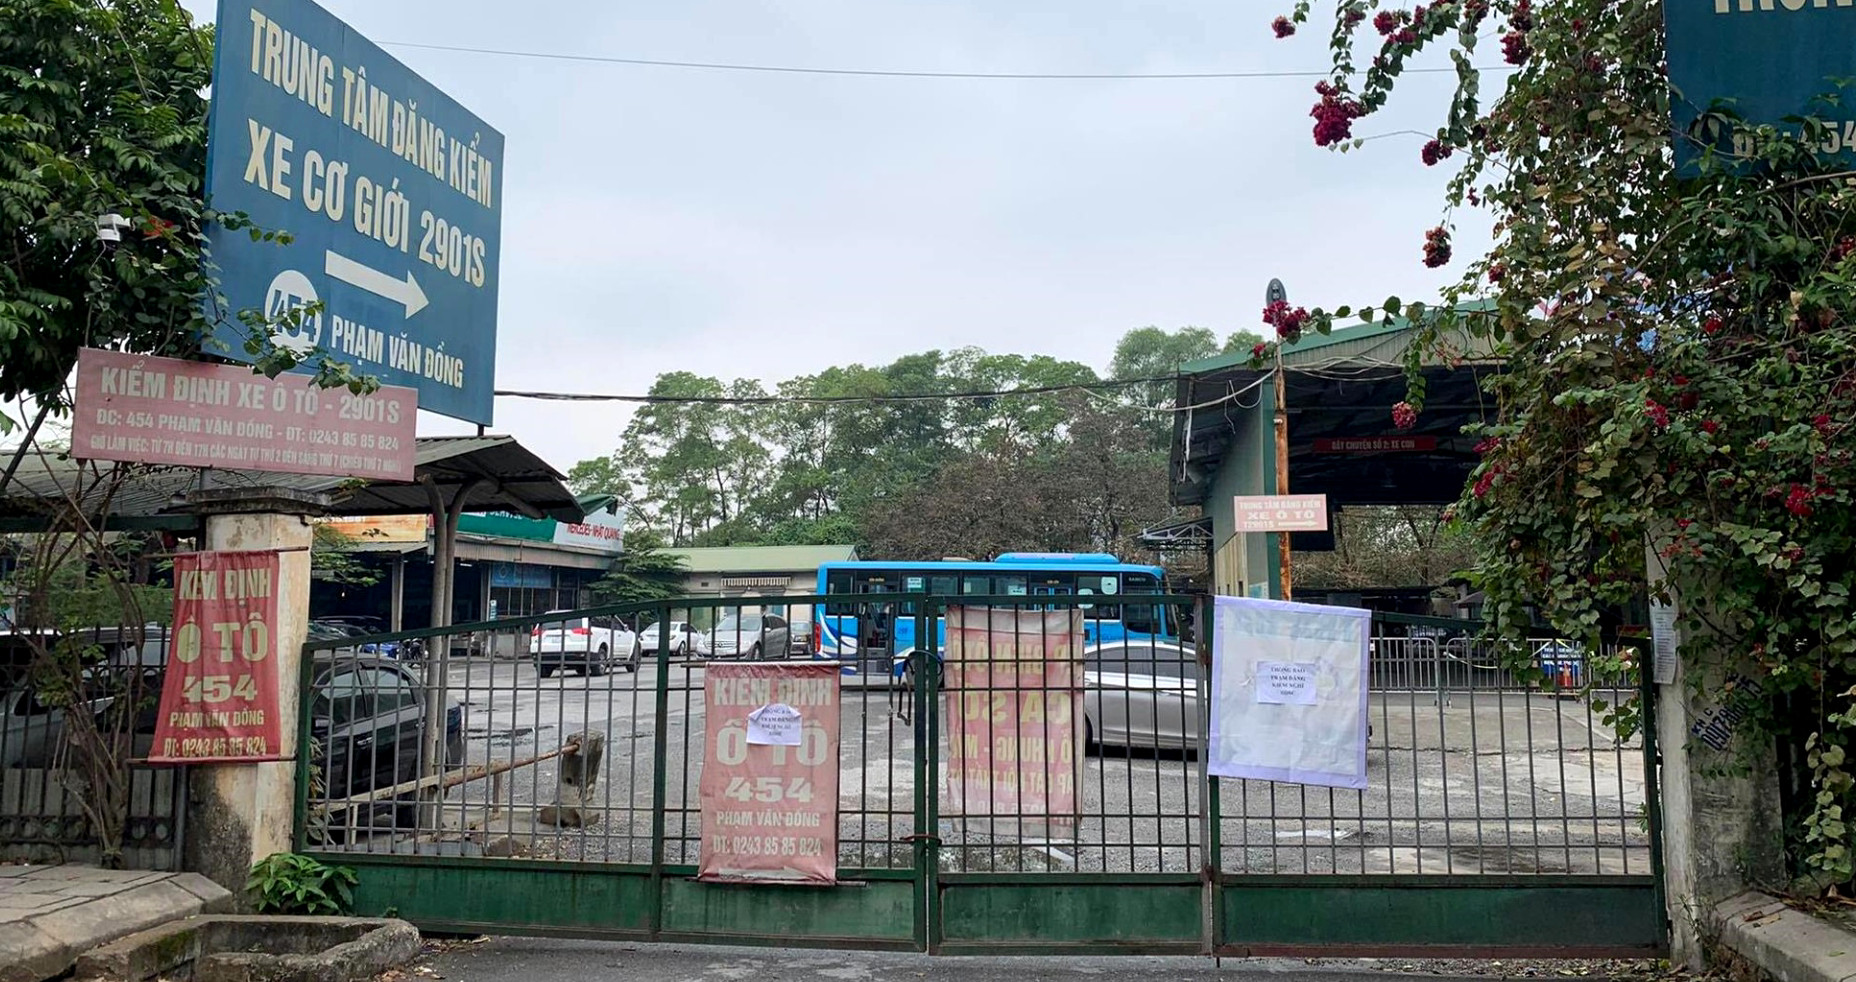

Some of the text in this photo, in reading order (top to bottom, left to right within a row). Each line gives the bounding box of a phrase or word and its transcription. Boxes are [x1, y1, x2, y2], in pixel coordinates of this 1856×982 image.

[250, 8, 493, 208] TRUNG TÂM ĐĂNG KIỂM
[243, 118, 486, 288] XE CƠ GIỚI 2901S
[331, 314, 463, 389] PHẠM VĂN ĐỒNG
[101, 360, 166, 399] KIỂM
[173, 375, 231, 408] ĐỊNH
[236, 381, 265, 410] XE
[272, 382, 287, 411] Ô
[294, 386, 319, 415] TÔ
[338, 394, 400, 424] 2901S
[96, 408, 122, 426] ĐC:
[125, 411, 154, 428] 454
[158, 414, 200, 434] PHẠM
[204, 416, 233, 436] VĂN
[286, 426, 306, 442] ĐT:
[309, 428, 339, 445] 0243
[342, 433, 357, 447] 85
[360, 434, 375, 448] 85
[378, 436, 399, 450] 824
[1247, 511, 1270, 520] XE
[225, 568, 271, 606] ĐỊNH
[177, 612, 268, 664] Ô TÔ
[182, 674, 258, 703] 454
[170, 711, 203, 732] PHẠM
[233, 704, 265, 726] ĐỒNG
[182, 738, 211, 758] 0243
[212, 738, 226, 757] 85
[246, 736, 267, 757] 824
[717, 718, 747, 766] Ô
[724, 776, 814, 803] 454
[716, 810, 753, 829] PHẠM
[756, 808, 781, 826] VĂN
[733, 836, 761, 855] 0243
[764, 837, 779, 855] 85
[781, 837, 797, 856] 85
[800, 837, 821, 857] 824
